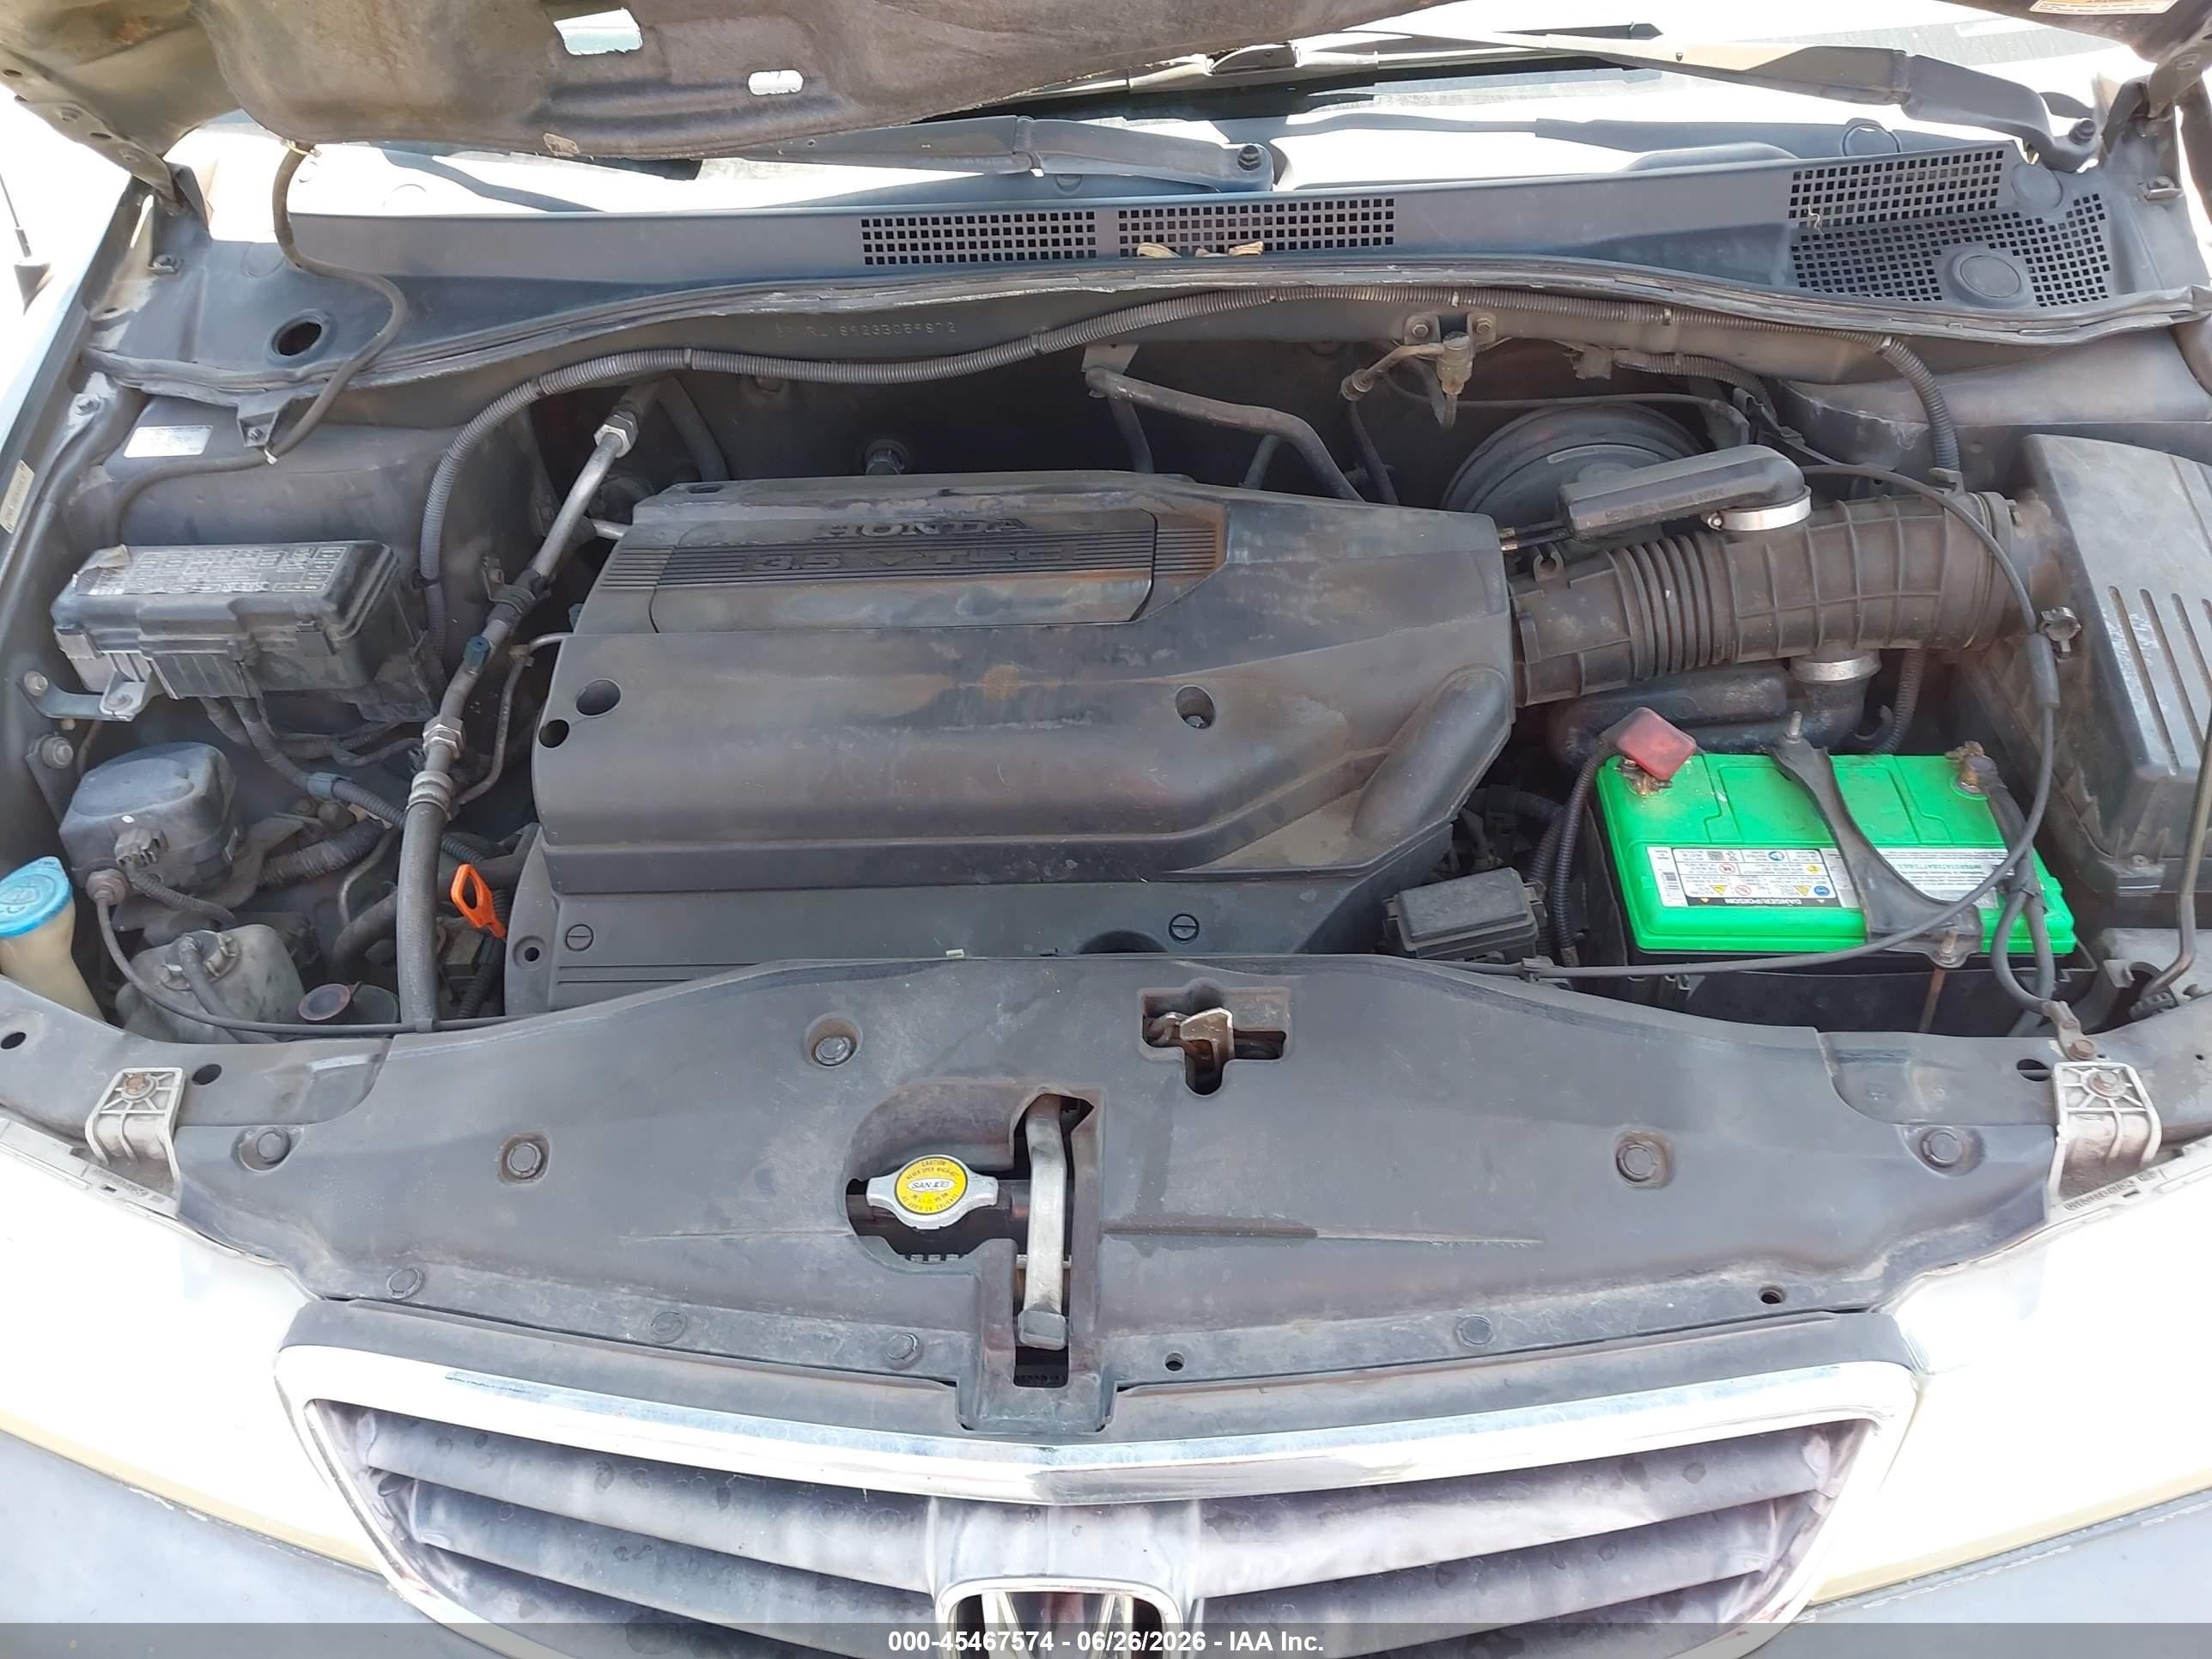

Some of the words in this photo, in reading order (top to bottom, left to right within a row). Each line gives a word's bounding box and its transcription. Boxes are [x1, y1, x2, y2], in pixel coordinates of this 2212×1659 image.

[824, 518, 1032, 539] HONDA
[752, 553, 841, 571] 3.5
[864, 546, 1061, 566] VTEC
